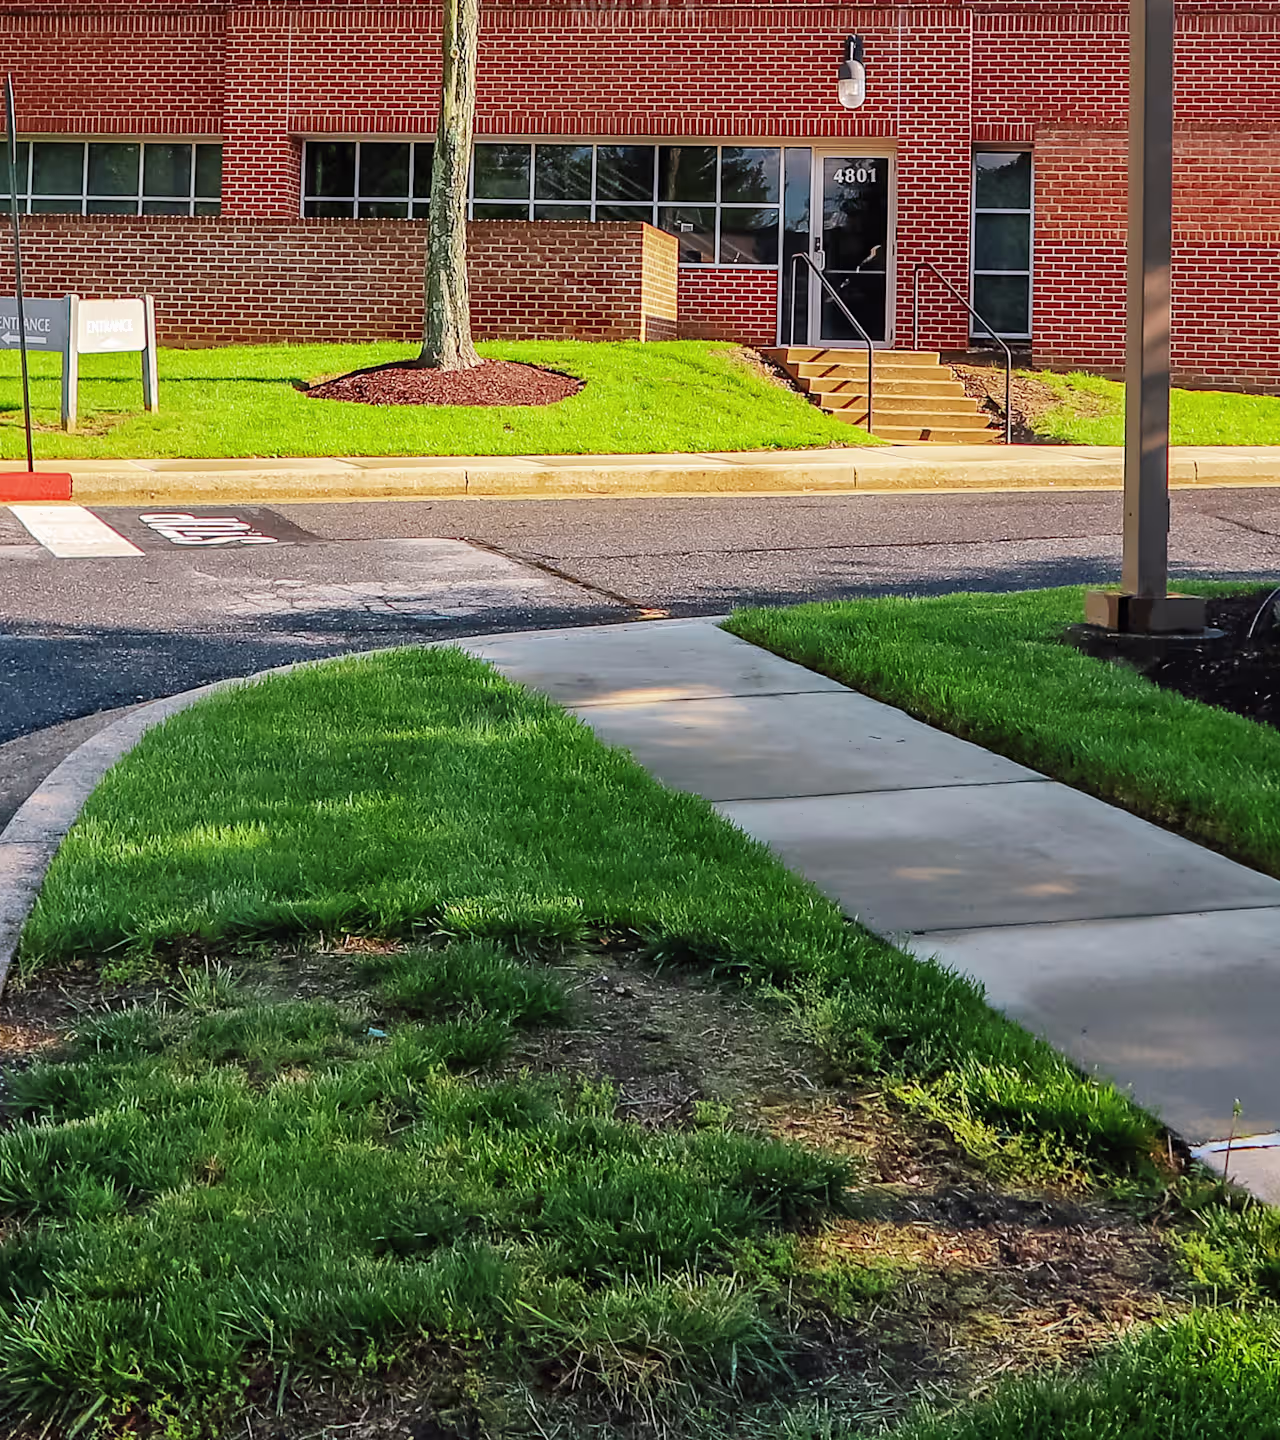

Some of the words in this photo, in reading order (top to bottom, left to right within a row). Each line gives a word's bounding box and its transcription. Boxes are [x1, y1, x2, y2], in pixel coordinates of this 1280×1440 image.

[833, 167, 877, 184] 4801
[87, 319, 133, 333] ENTRANCE
[138, 513, 279, 546] STOP
